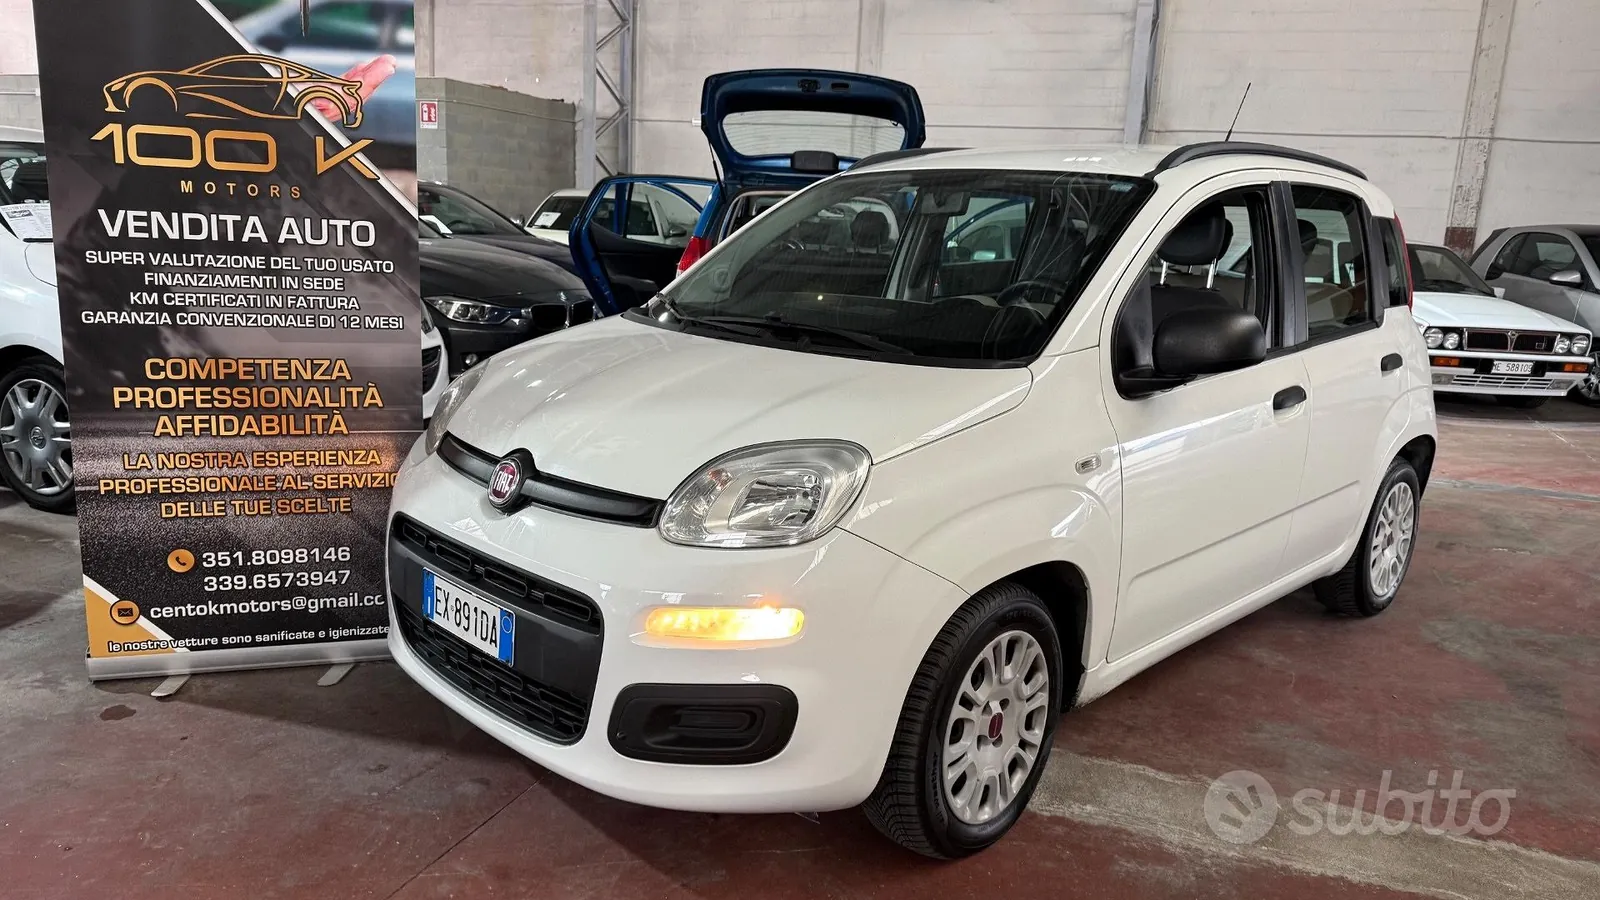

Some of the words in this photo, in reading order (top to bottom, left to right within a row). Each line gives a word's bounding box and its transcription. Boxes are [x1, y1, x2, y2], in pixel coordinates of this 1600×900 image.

[90, 123, 277, 173] 100
[180, 180, 301, 199] MOTORS
[98, 208, 268, 244] VENDITA
[277, 218, 376, 247] AUTO
[85, 250, 145, 266] SUPER
[148, 252, 266, 270] VALUTAZIONE
[270, 256, 301, 271] DEL
[304, 257, 337, 272] TUO
[340, 258, 394, 274] USATO
[144, 272, 277, 289] FINANZIAMENTI
[281, 276, 299, 290] IN
[302, 276, 344, 291] SEDE
[130, 291, 158, 306] KM
[163, 292, 262, 308] CERTIFICATI
[265, 294, 283, 308] IN
[286, 294, 359, 310] FATTURA
[81, 311, 171, 326] GARANZIA
[176, 312, 315, 328] CONVENZIONALE
[318, 314, 335, 329] DI
[339, 315, 360, 329] 12
[364, 315, 403, 329] MESI
[144, 357, 351, 381] COMPETENZA
[113, 382, 383, 408] PROFESSIONALITÀ
[154, 410, 349, 436] AFFIDABILITÀ
[123, 453, 151, 470] LA
[157, 452, 248, 469] NOSTRA
[253, 449, 382, 467] ESPERIENZA
[99, 475, 277, 495] PROFESSIONALE
[281, 475, 309, 490] AL
[493, 470, 514, 494] FIAT
[161, 501, 225, 518] DELLE
[231, 500, 272, 516] TUE
[276, 497, 352, 515] SCELTE
[202, 546, 351, 568] 351.8098146
[203, 569, 350, 592] 339.6573947
[435, 585, 450, 621] EX
[454, 597, 498, 648] 891DA
[108, 641, 121, 652] le
[123, 638, 167, 651] nostre
[170, 636, 218, 649] vetture
[221, 634, 252, 646] sono
[255, 628, 315, 643] sanificate
[318, 629, 326, 638] e
